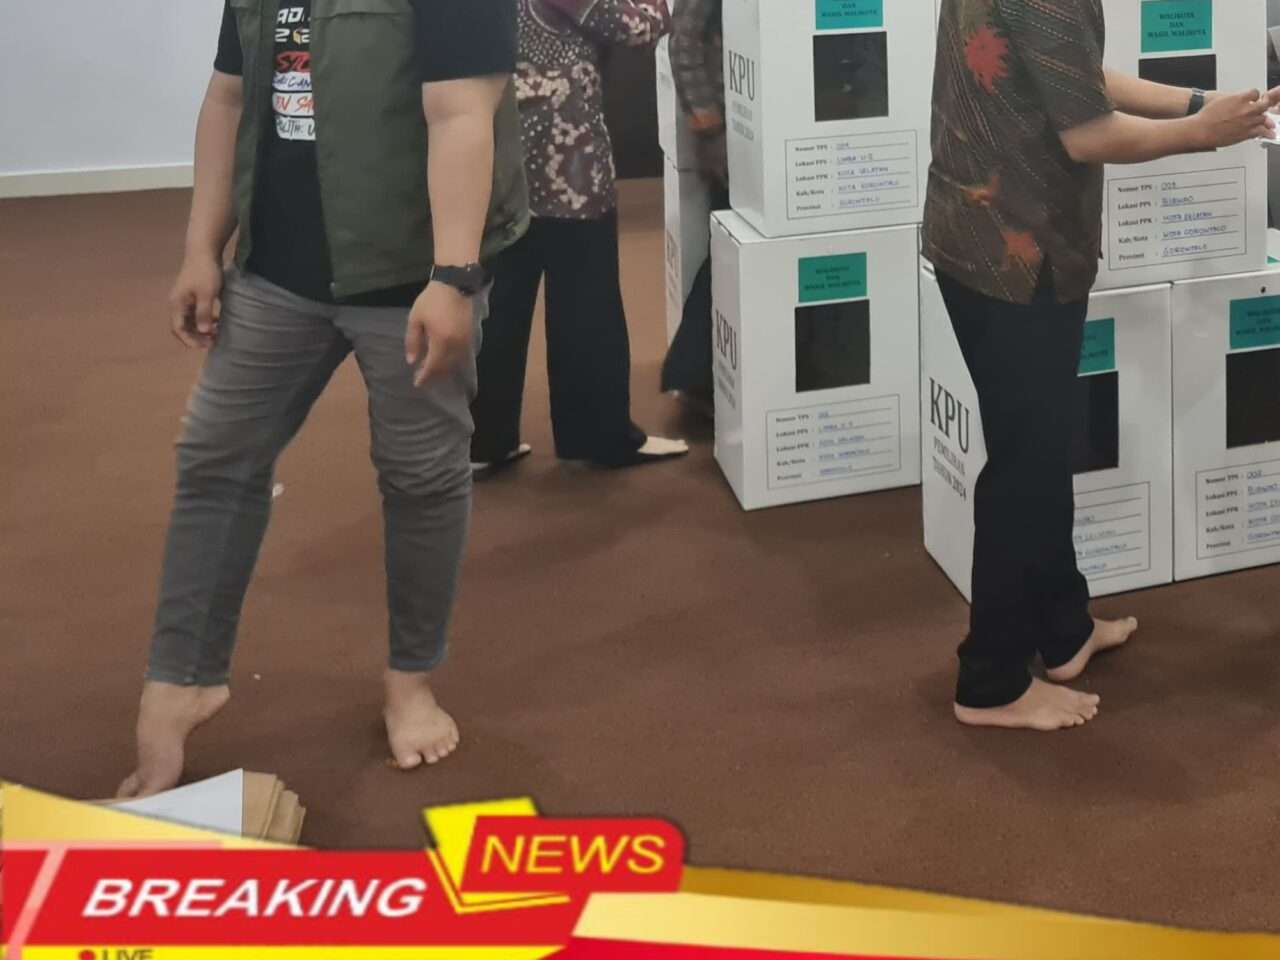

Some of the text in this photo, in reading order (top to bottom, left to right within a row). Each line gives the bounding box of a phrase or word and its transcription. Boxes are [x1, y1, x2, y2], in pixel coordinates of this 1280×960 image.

[728, 49, 756, 101] KPU
[715, 308, 737, 371] KPU
[929, 377, 970, 454] KPU
